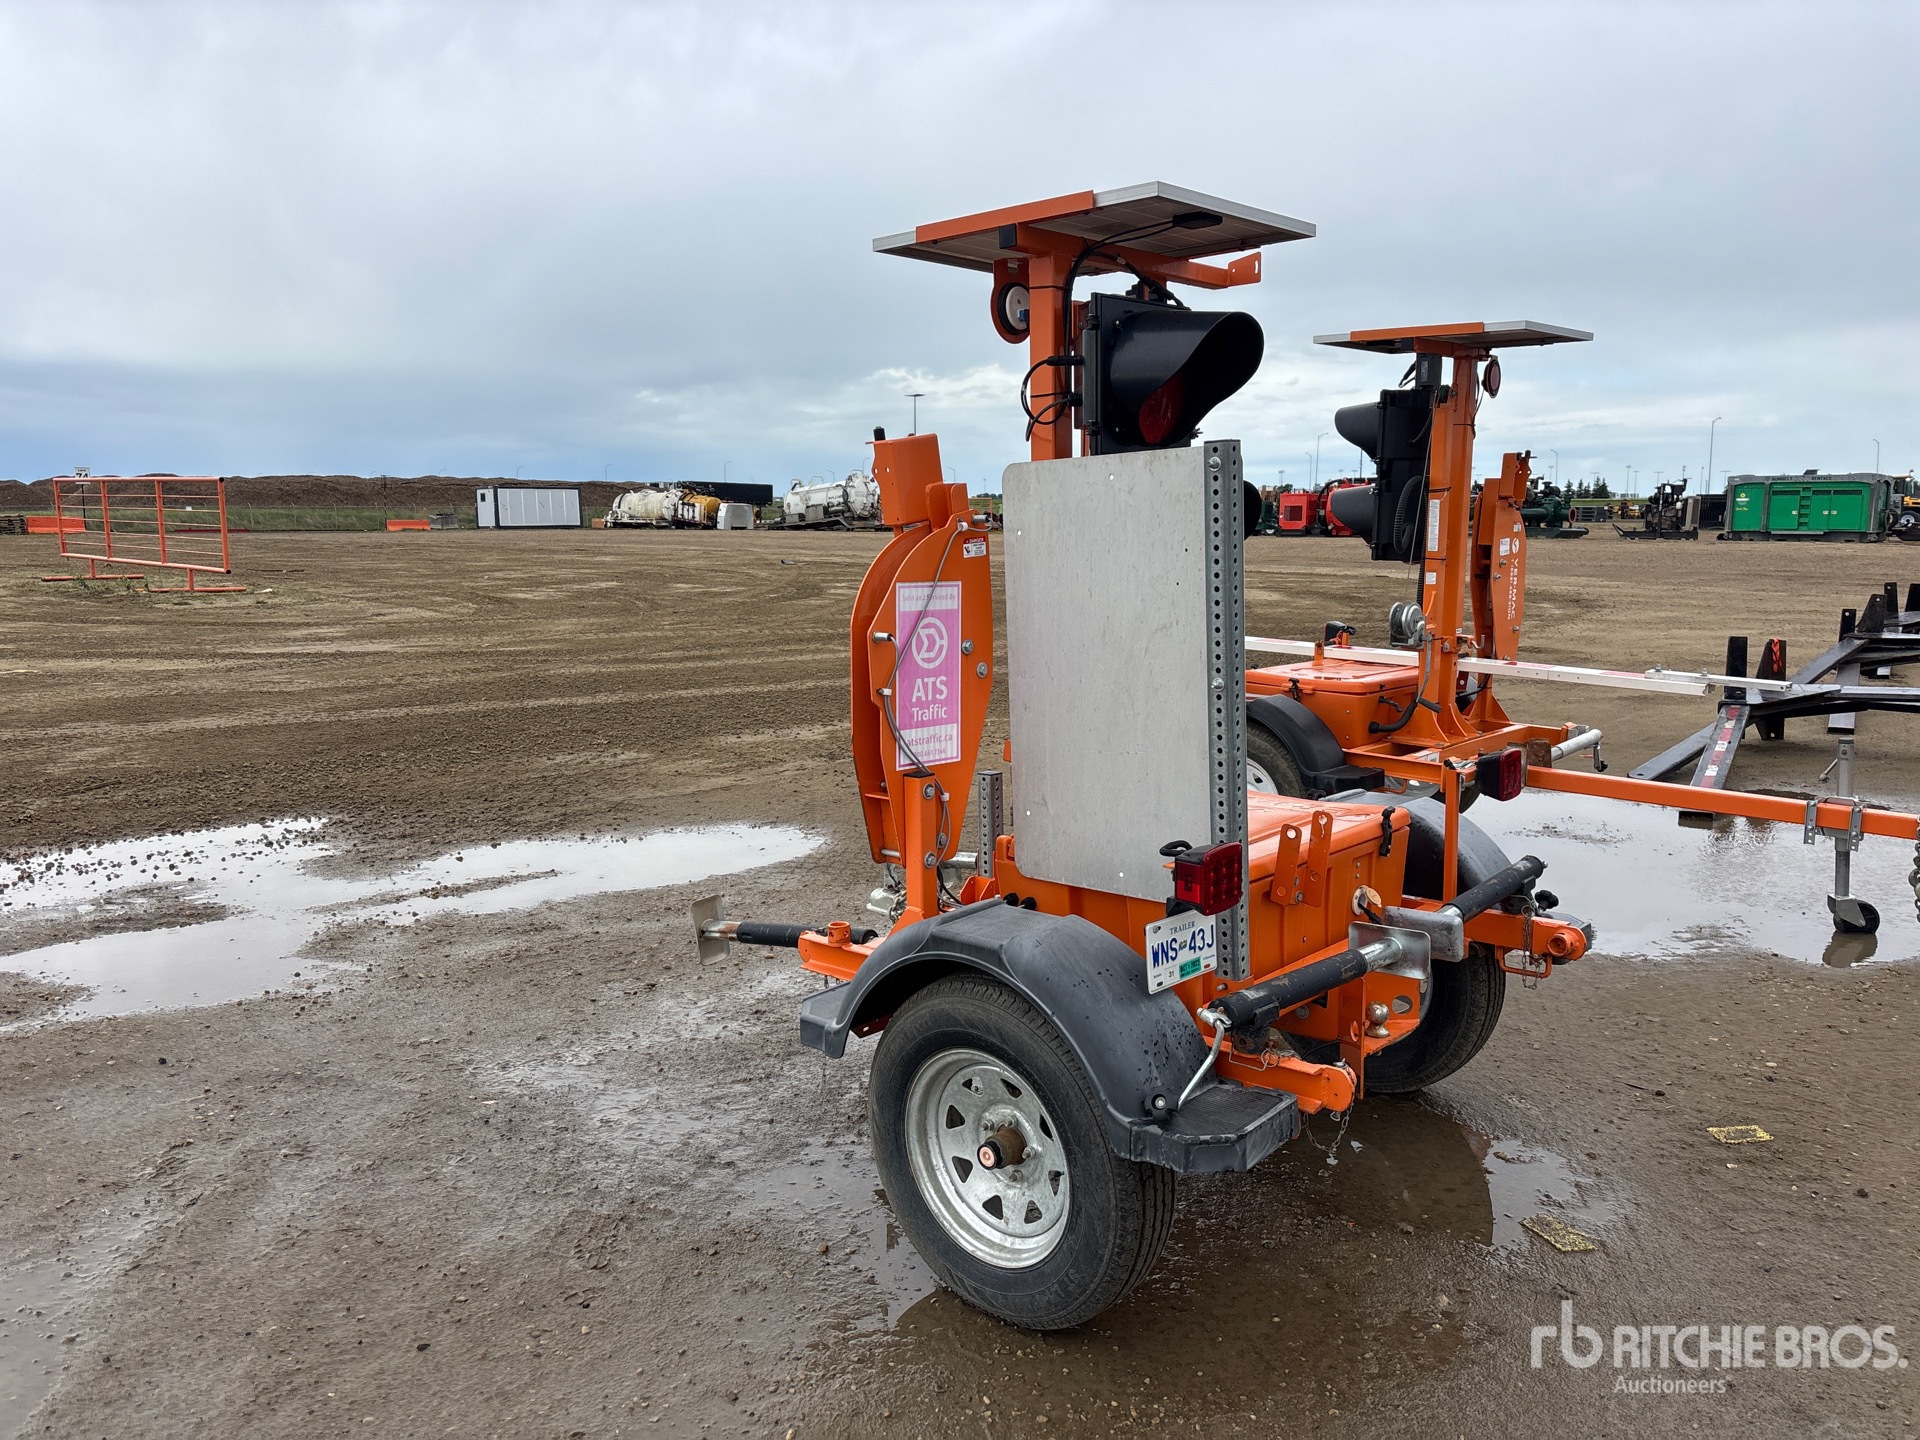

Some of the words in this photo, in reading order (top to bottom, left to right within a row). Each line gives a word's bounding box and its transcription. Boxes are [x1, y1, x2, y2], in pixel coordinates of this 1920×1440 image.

[1511, 558, 1519, 619] VER-MAC
[911, 675, 948, 702] ATS
[911, 703, 948, 722] Traffic
[907, 733, 953, 747] atstraffic.ca
[1170, 920, 1196, 935] TRAILER
[1151, 937, 1178, 969] WNS
[1188, 924, 1214, 953] 43J
